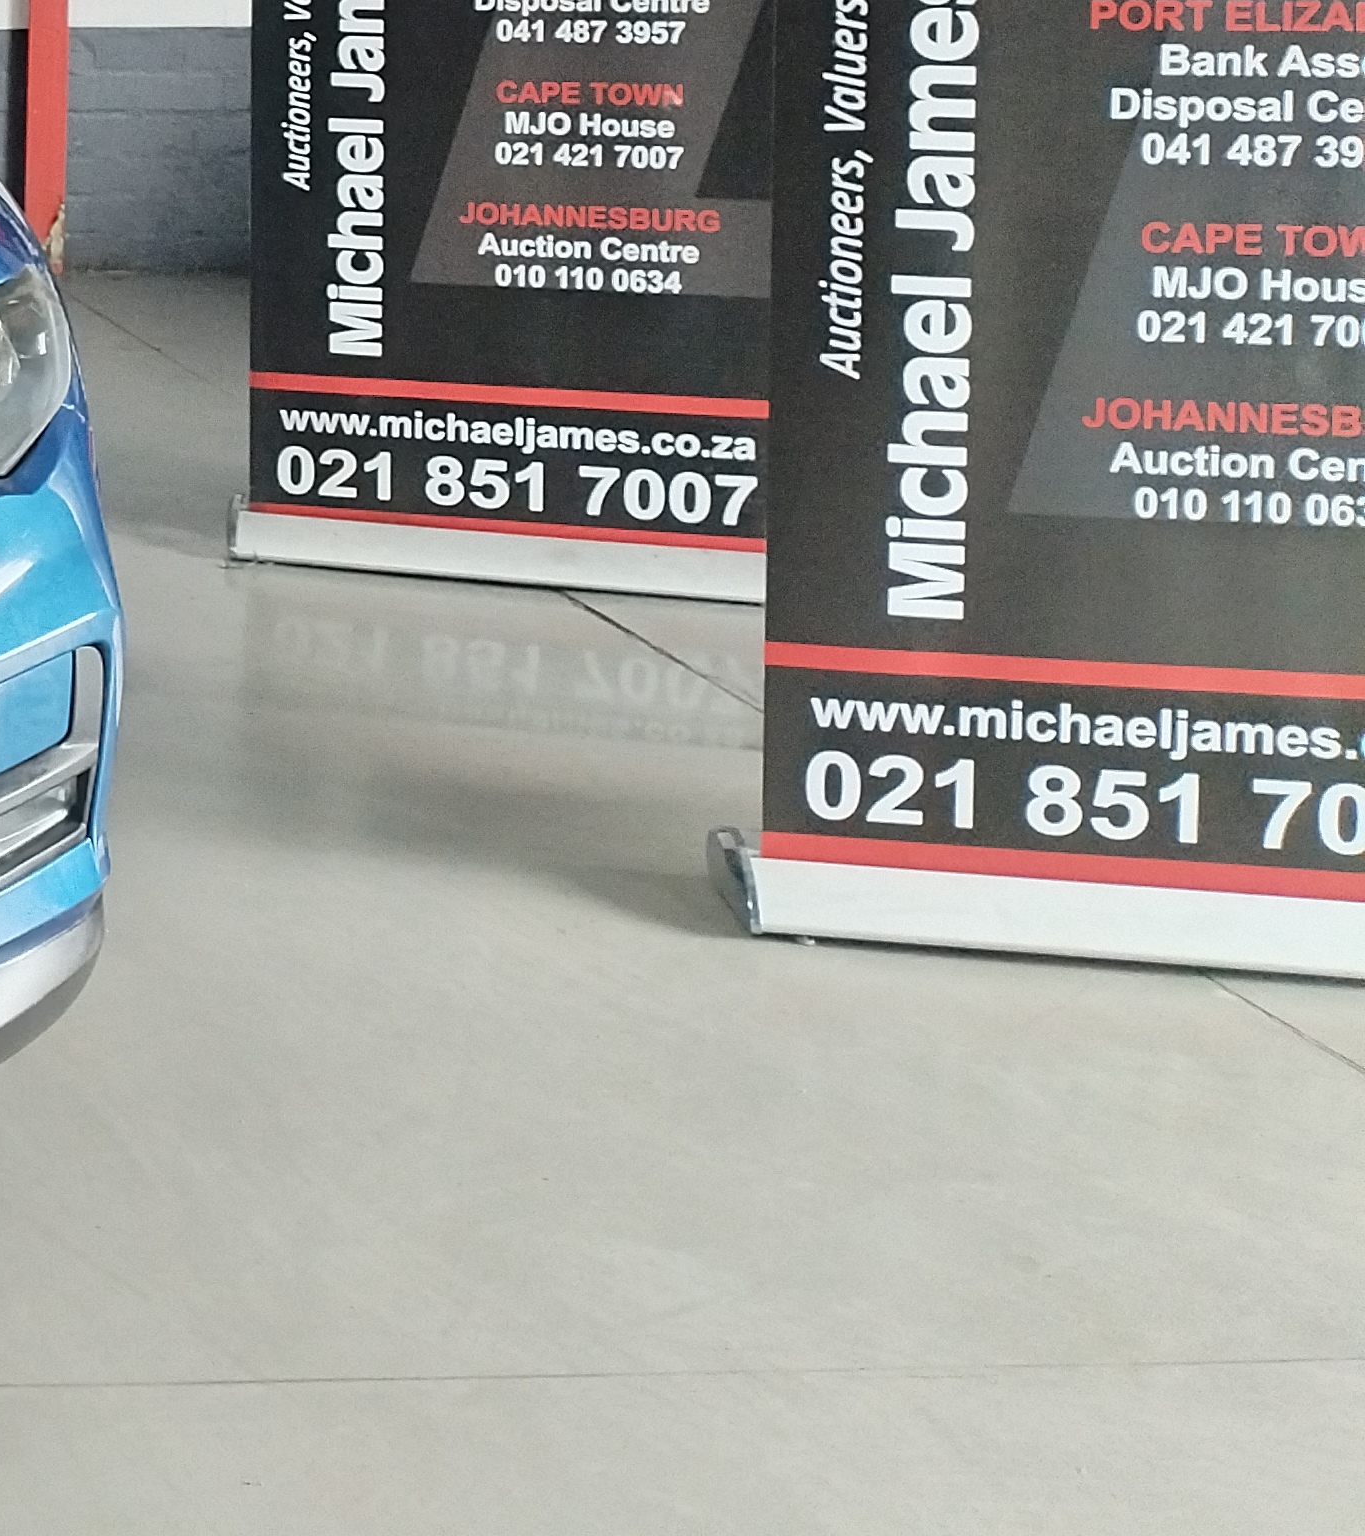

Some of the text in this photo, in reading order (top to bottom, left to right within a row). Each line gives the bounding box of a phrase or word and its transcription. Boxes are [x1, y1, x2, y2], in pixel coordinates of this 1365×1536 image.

[496, 20, 687, 45] 041 487 3957
[1090, 0, 1365, 32] PORT ELIZA
[1159, 44, 1365, 77] Bank Ass
[283, 31, 316, 191] Auctioneers,
[495, 81, 685, 107] CAPE TOWN
[1110, 88, 1294, 127] Disposal
[504, 111, 676, 138] MJO House
[494, 142, 685, 170] 021 421 7007
[1141, 133, 1302, 167] 041 487
[459, 202, 722, 233] JOHANNESBURG
[327, 118, 385, 357] Michael
[478, 233, 701, 265] Auction Centre
[1141, 221, 1365, 257] CAPE TOW
[494, 264, 683, 295] 010 110 0634
[818, 151, 874, 380] Auctioneers,
[1152, 266, 1365, 302] MJO Hous
[1137, 310, 1293, 345] 021 421
[279, 407, 758, 462] www.michaeljames.co.za
[1081, 397, 1365, 438] JOHANNESB
[886, 275, 973, 622] Michael
[1109, 441, 1275, 479] Auction
[276, 445, 760, 527] 021 851 7007
[1134, 486, 1292, 524] 010 110
[811, 695, 1365, 761] www.michaeljames.
[804, 749, 1200, 846] 021 851
